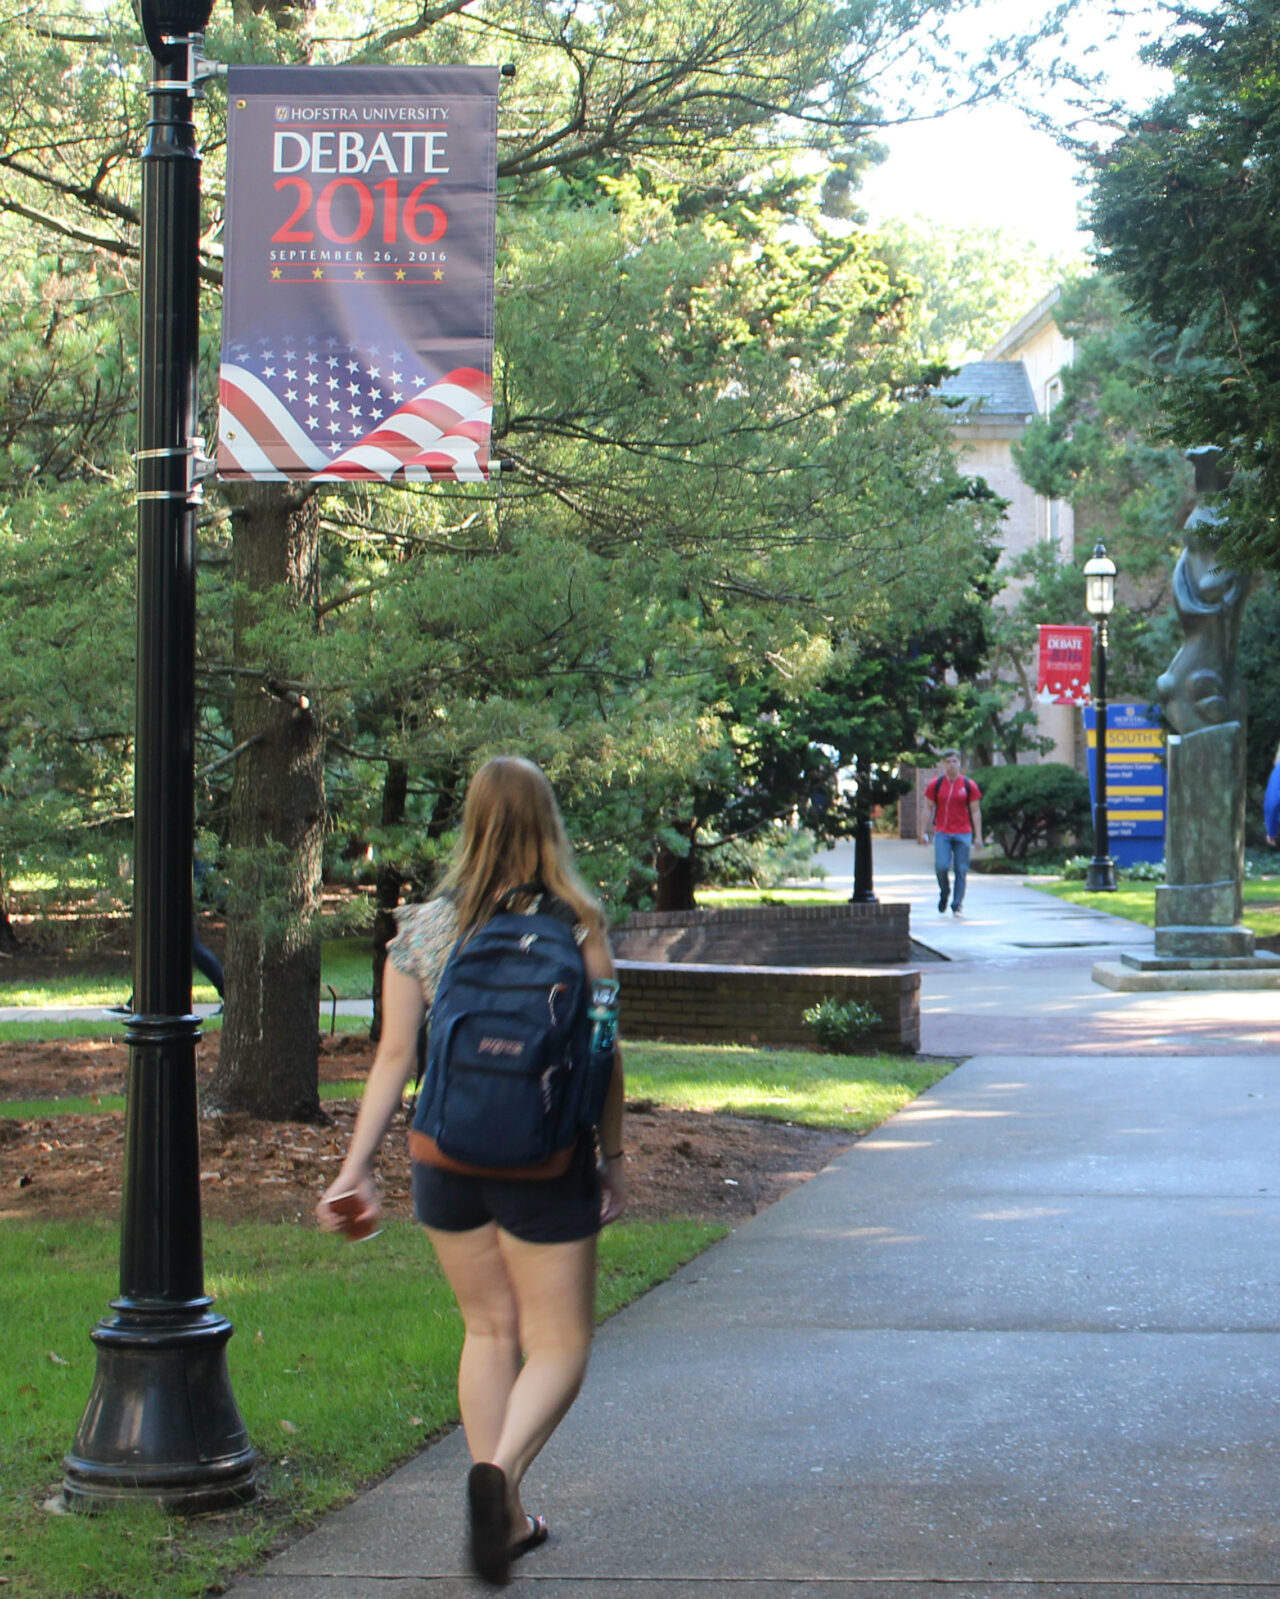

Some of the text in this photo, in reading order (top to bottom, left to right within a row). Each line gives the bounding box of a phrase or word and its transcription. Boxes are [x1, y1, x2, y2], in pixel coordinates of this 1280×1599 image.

[291, 107, 358, 120] HOFSTRA
[273, 131, 450, 173] DEBATE
[270, 176, 448, 244] 2016
[269, 250, 447, 263] SEPTEMBER 26, 2016
[1047, 639, 1083, 650] DEBATE
[1108, 732, 1153, 744] SOUTH
